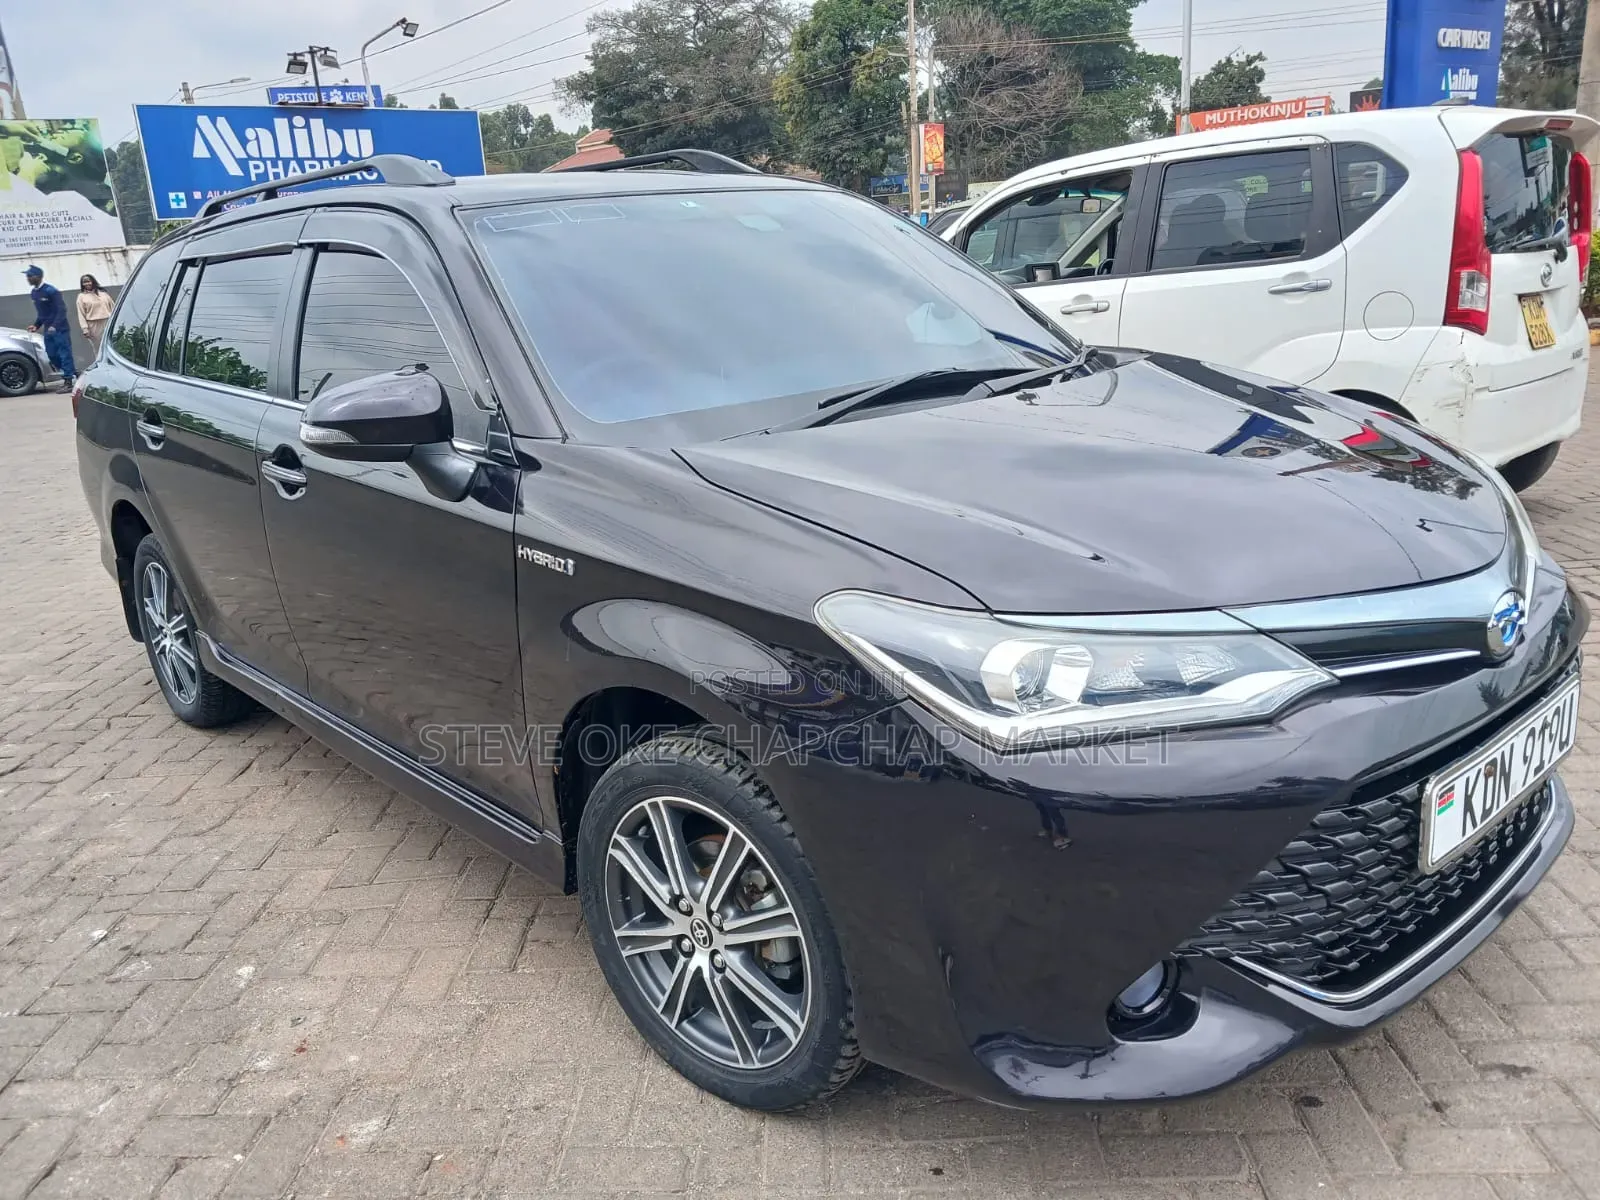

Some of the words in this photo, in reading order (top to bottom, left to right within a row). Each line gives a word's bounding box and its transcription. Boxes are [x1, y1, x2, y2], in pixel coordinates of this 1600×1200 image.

[1437, 28, 1460, 48] CAR
[1461, 30, 1491, 50] WASH
[1205, 101, 1304, 126] MUTHOKINJU
[193, 115, 374, 176] Malibu
[248, 158, 379, 181] PHARMAC
[517, 544, 566, 573] HYBRID
[1462, 742, 1514, 838] KDN
[1522, 692, 1575, 788] 919U
